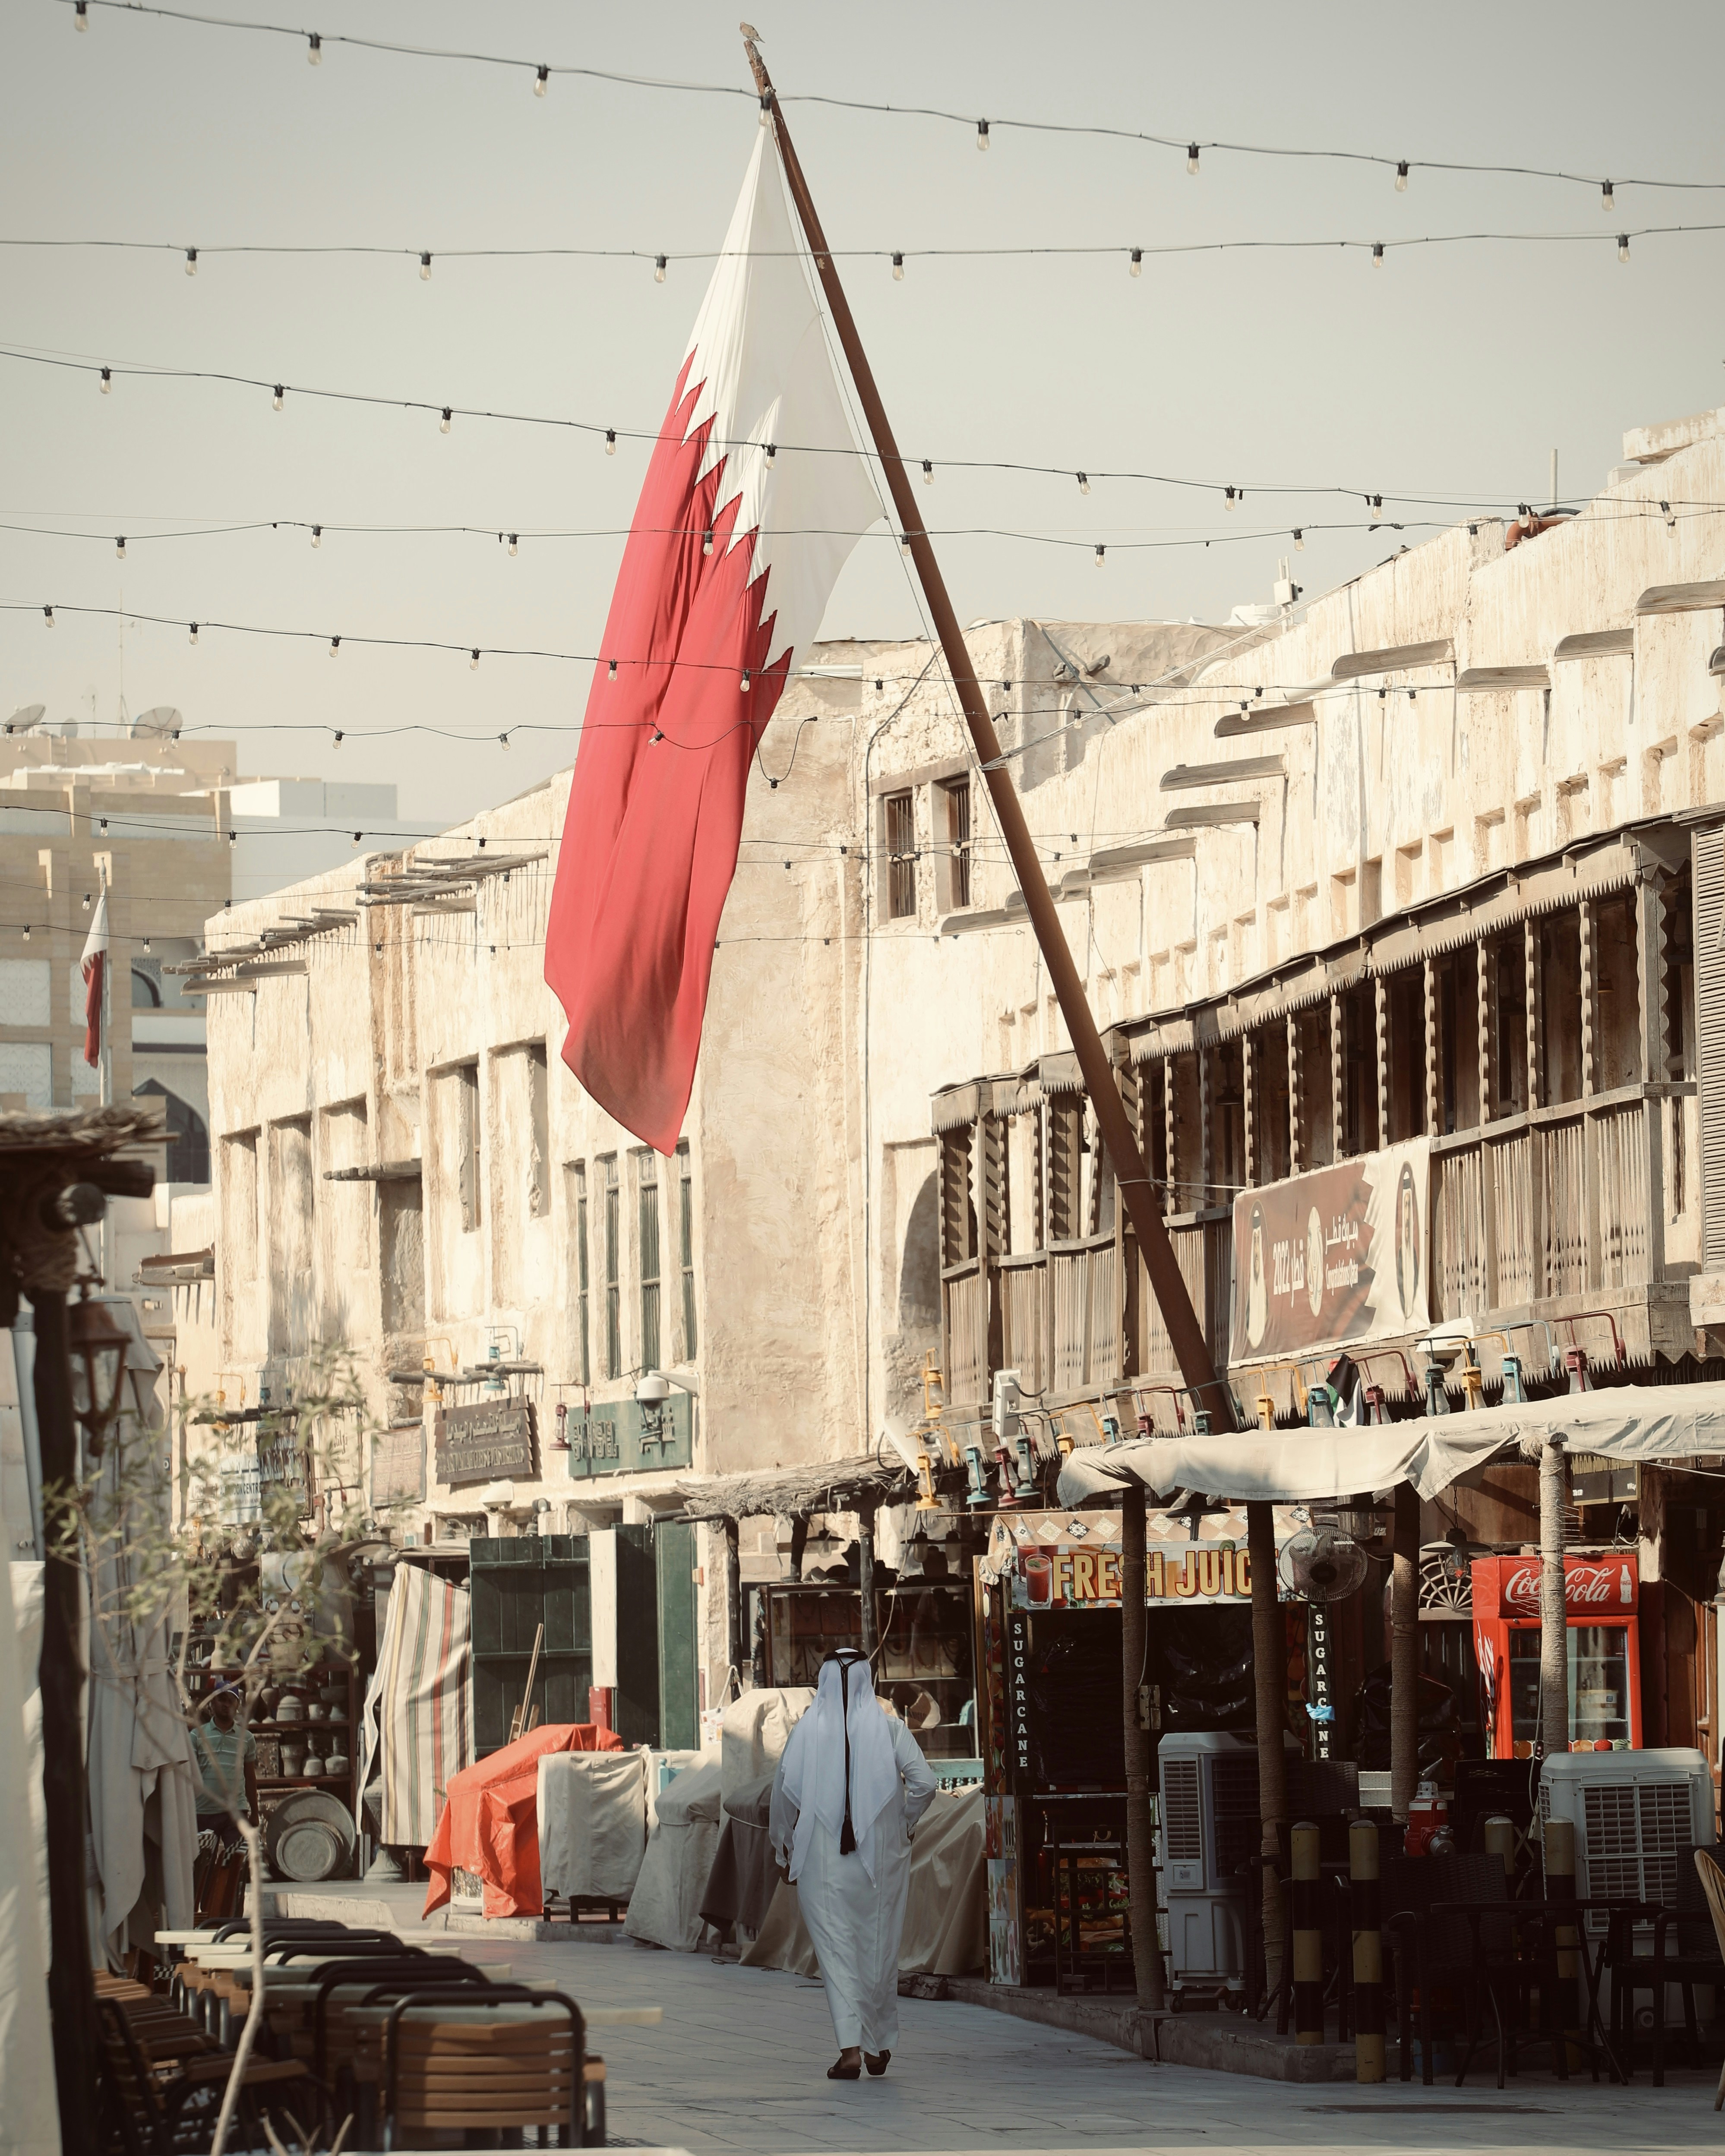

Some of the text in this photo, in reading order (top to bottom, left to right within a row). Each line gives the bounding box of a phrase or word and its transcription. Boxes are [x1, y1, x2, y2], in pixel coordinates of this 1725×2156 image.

[1325, 1215, 1341, 1255] قطر
[1273, 1238, 1304, 1308] قطر 2022
[1052, 1548, 1280, 1600] FREH JUIC
[1013, 1623, 1028, 1767] SUGARCANE
